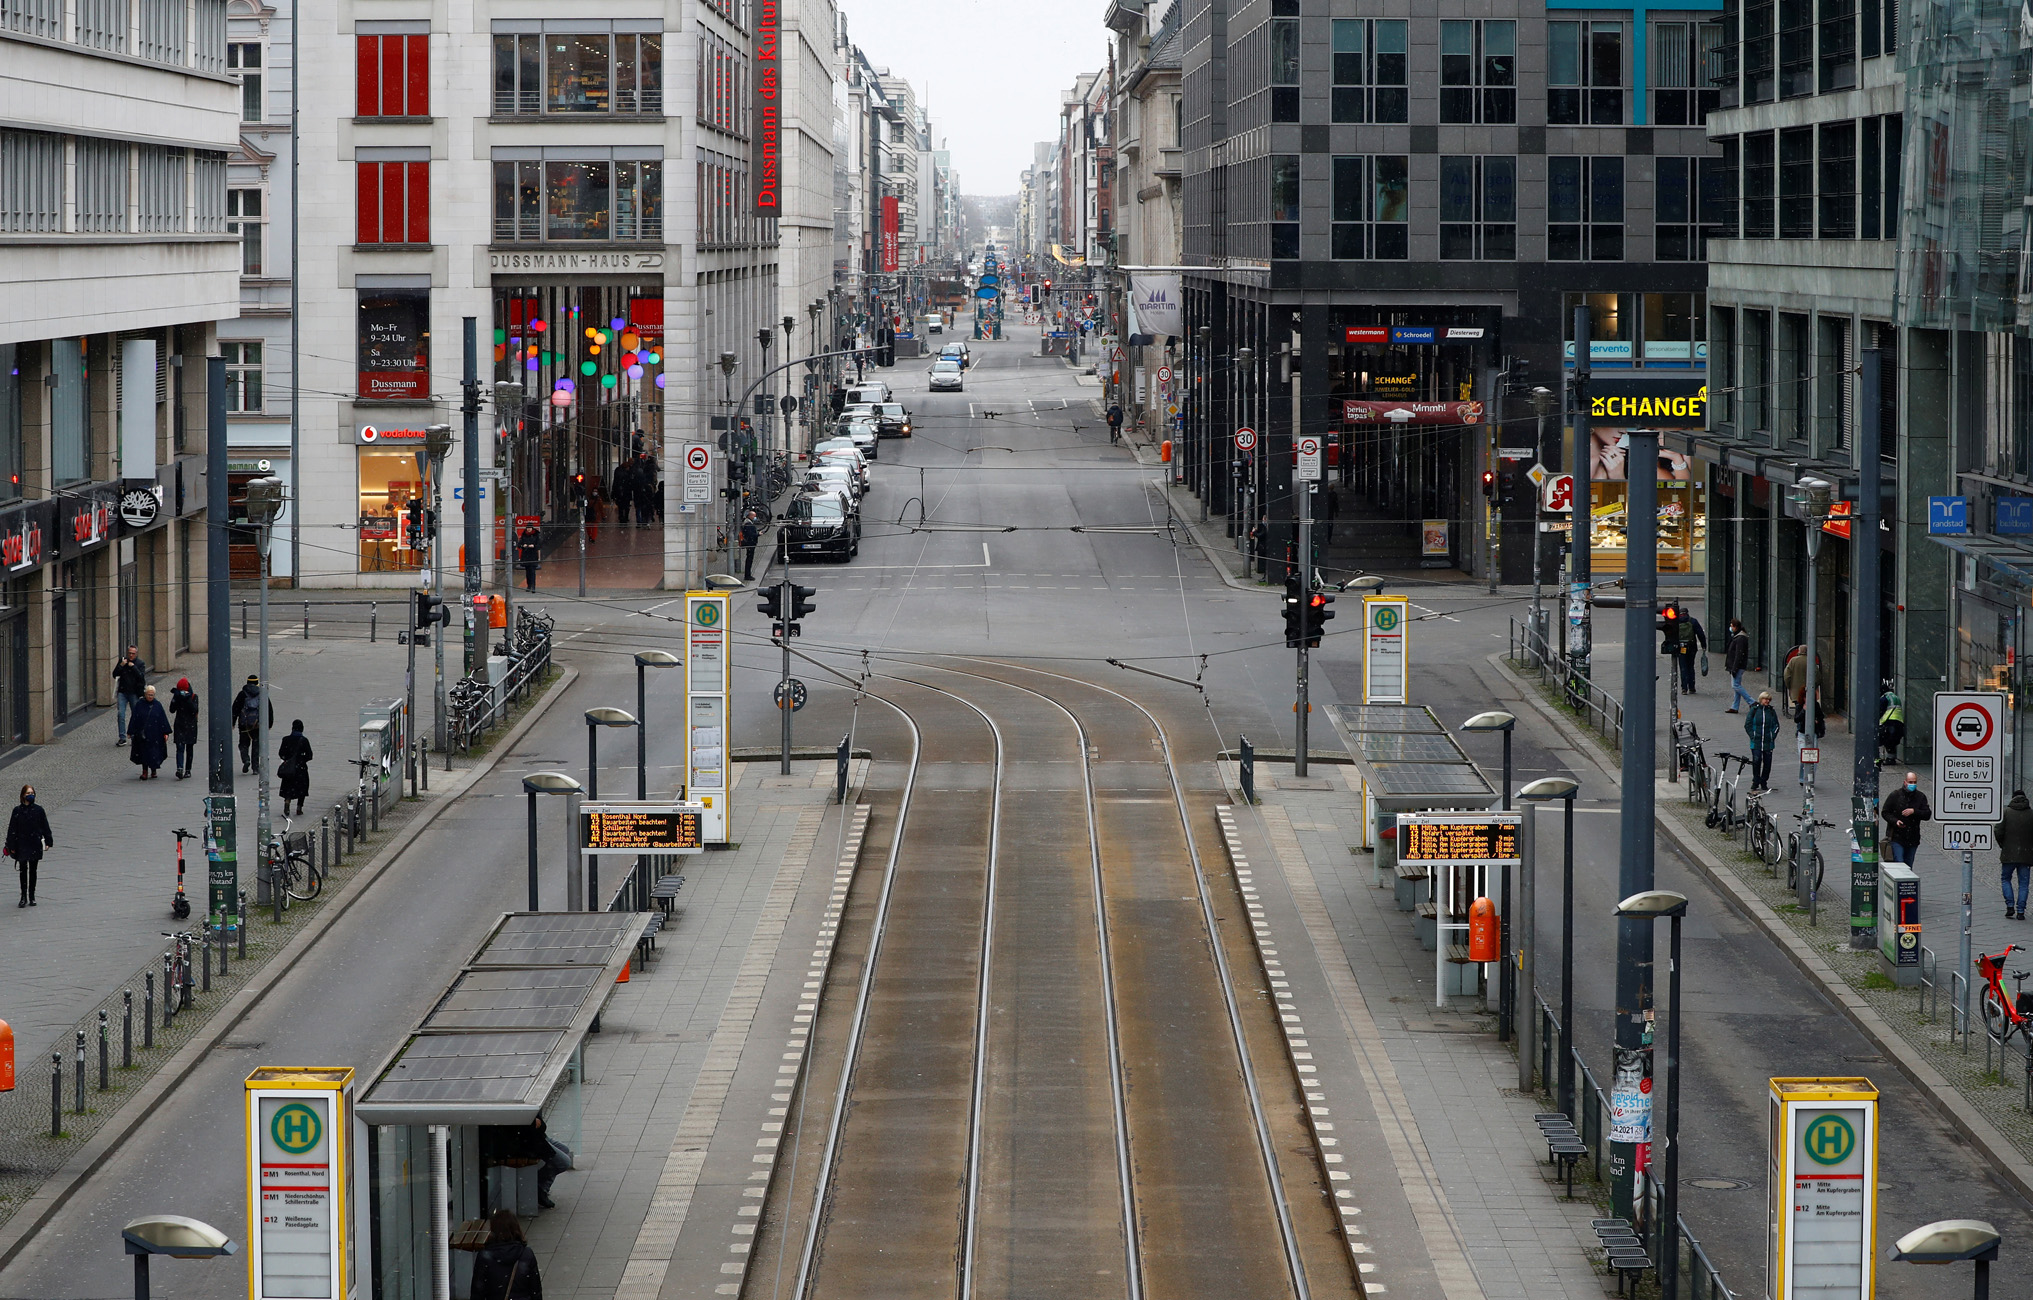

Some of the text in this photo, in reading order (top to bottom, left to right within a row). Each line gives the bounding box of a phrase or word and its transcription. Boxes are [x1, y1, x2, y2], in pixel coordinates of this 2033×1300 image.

[758, 67, 776, 100] das
[758, 106, 776, 207] Dussmann
[491, 255, 631, 268] DUSSMANN-HAUS
[371, 380, 417, 388] Dussmann
[1412, 404, 1446, 412] Mmmh!
[380, 429, 426, 438] vodafone
[1240, 434, 1252, 444] 30
[1947, 760, 1990, 768] Diesel bis
[1948, 771, 1988, 780] Euro 5/V
[1948, 790, 1987, 800] Anlieger
[1960, 802, 1976, 810] frei
[1947, 831, 1987, 844] 100 m
[284, 1115, 308, 1142] H
[1818, 1126, 1842, 1154] H
[1614, 1154, 1625, 1164] km
